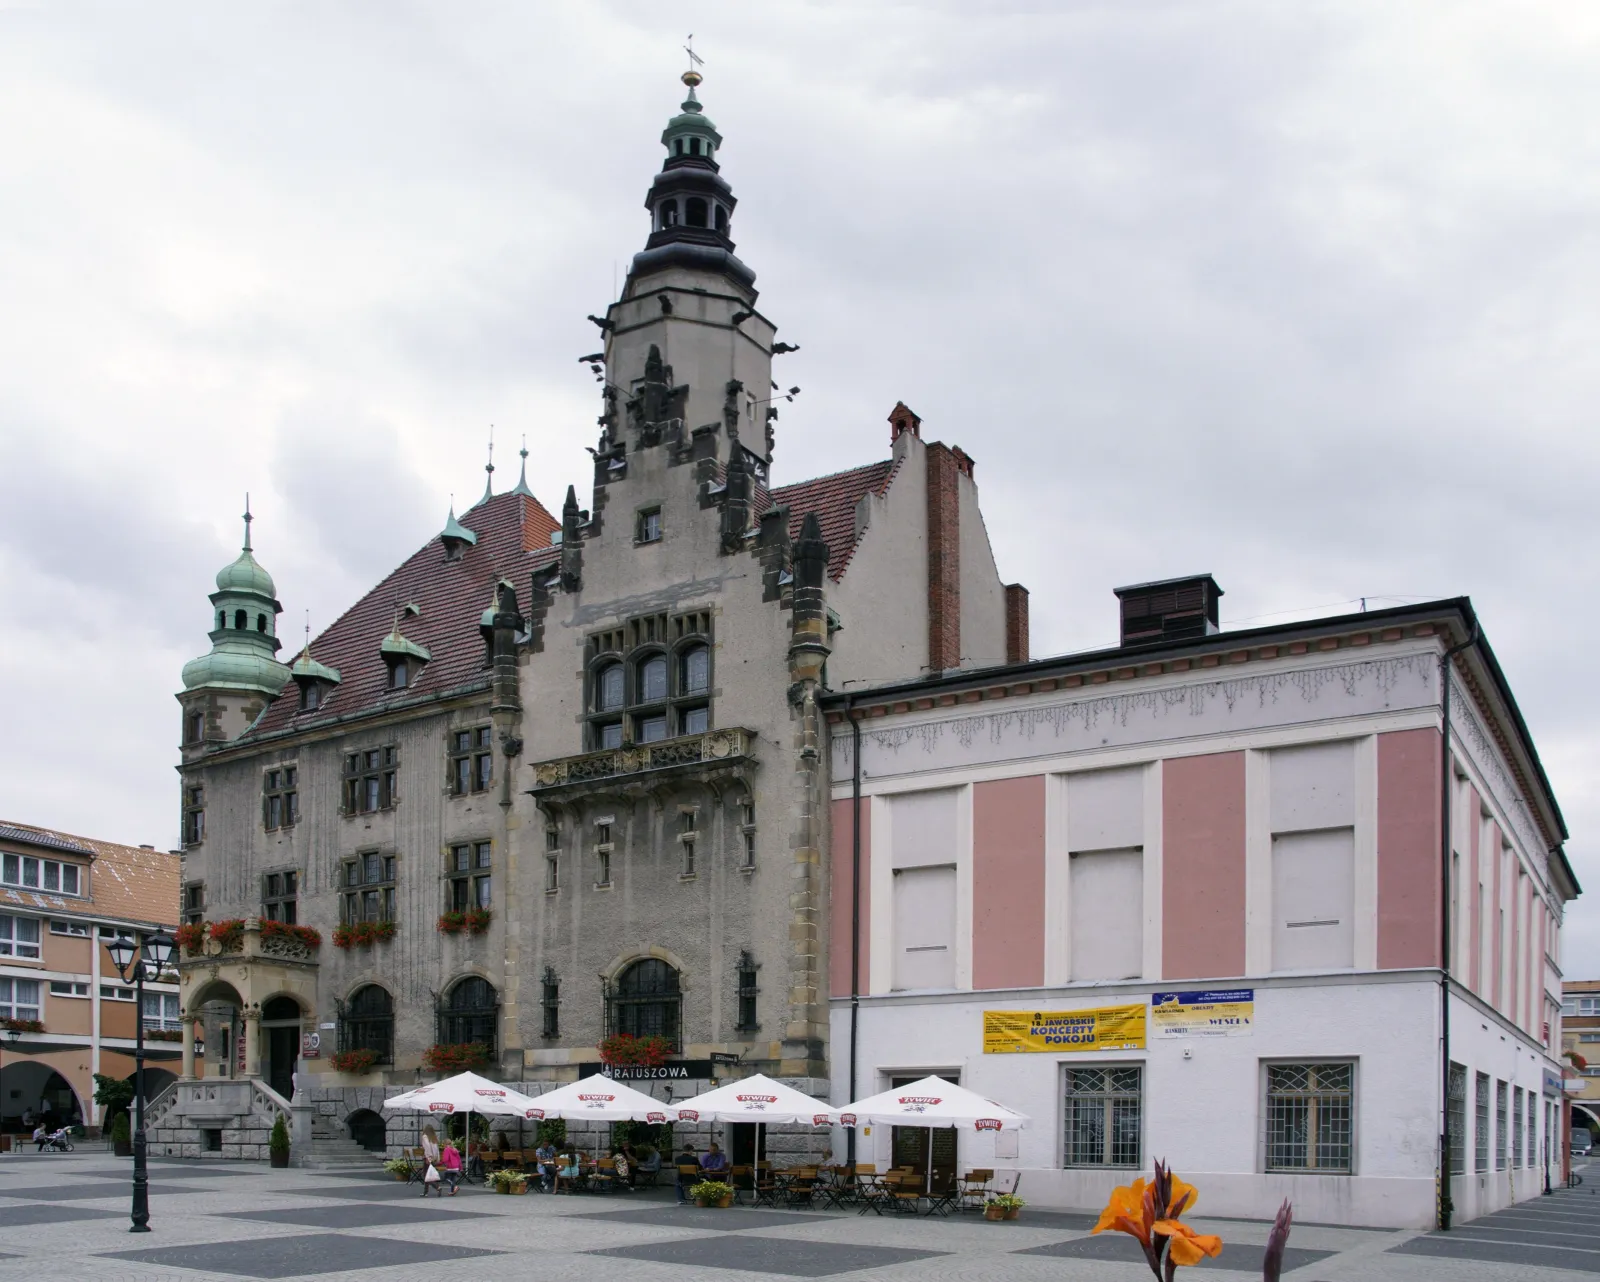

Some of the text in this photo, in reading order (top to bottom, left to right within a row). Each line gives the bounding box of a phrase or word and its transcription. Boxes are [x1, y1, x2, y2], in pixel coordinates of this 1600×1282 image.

[1044, 1017, 1095, 1026] JAWORSKIE
[1030, 1025, 1095, 1035] KONCERTY
[1045, 1034, 1095, 1044] POKOJU
[614, 1066, 689, 1079] RATUSZOWA
